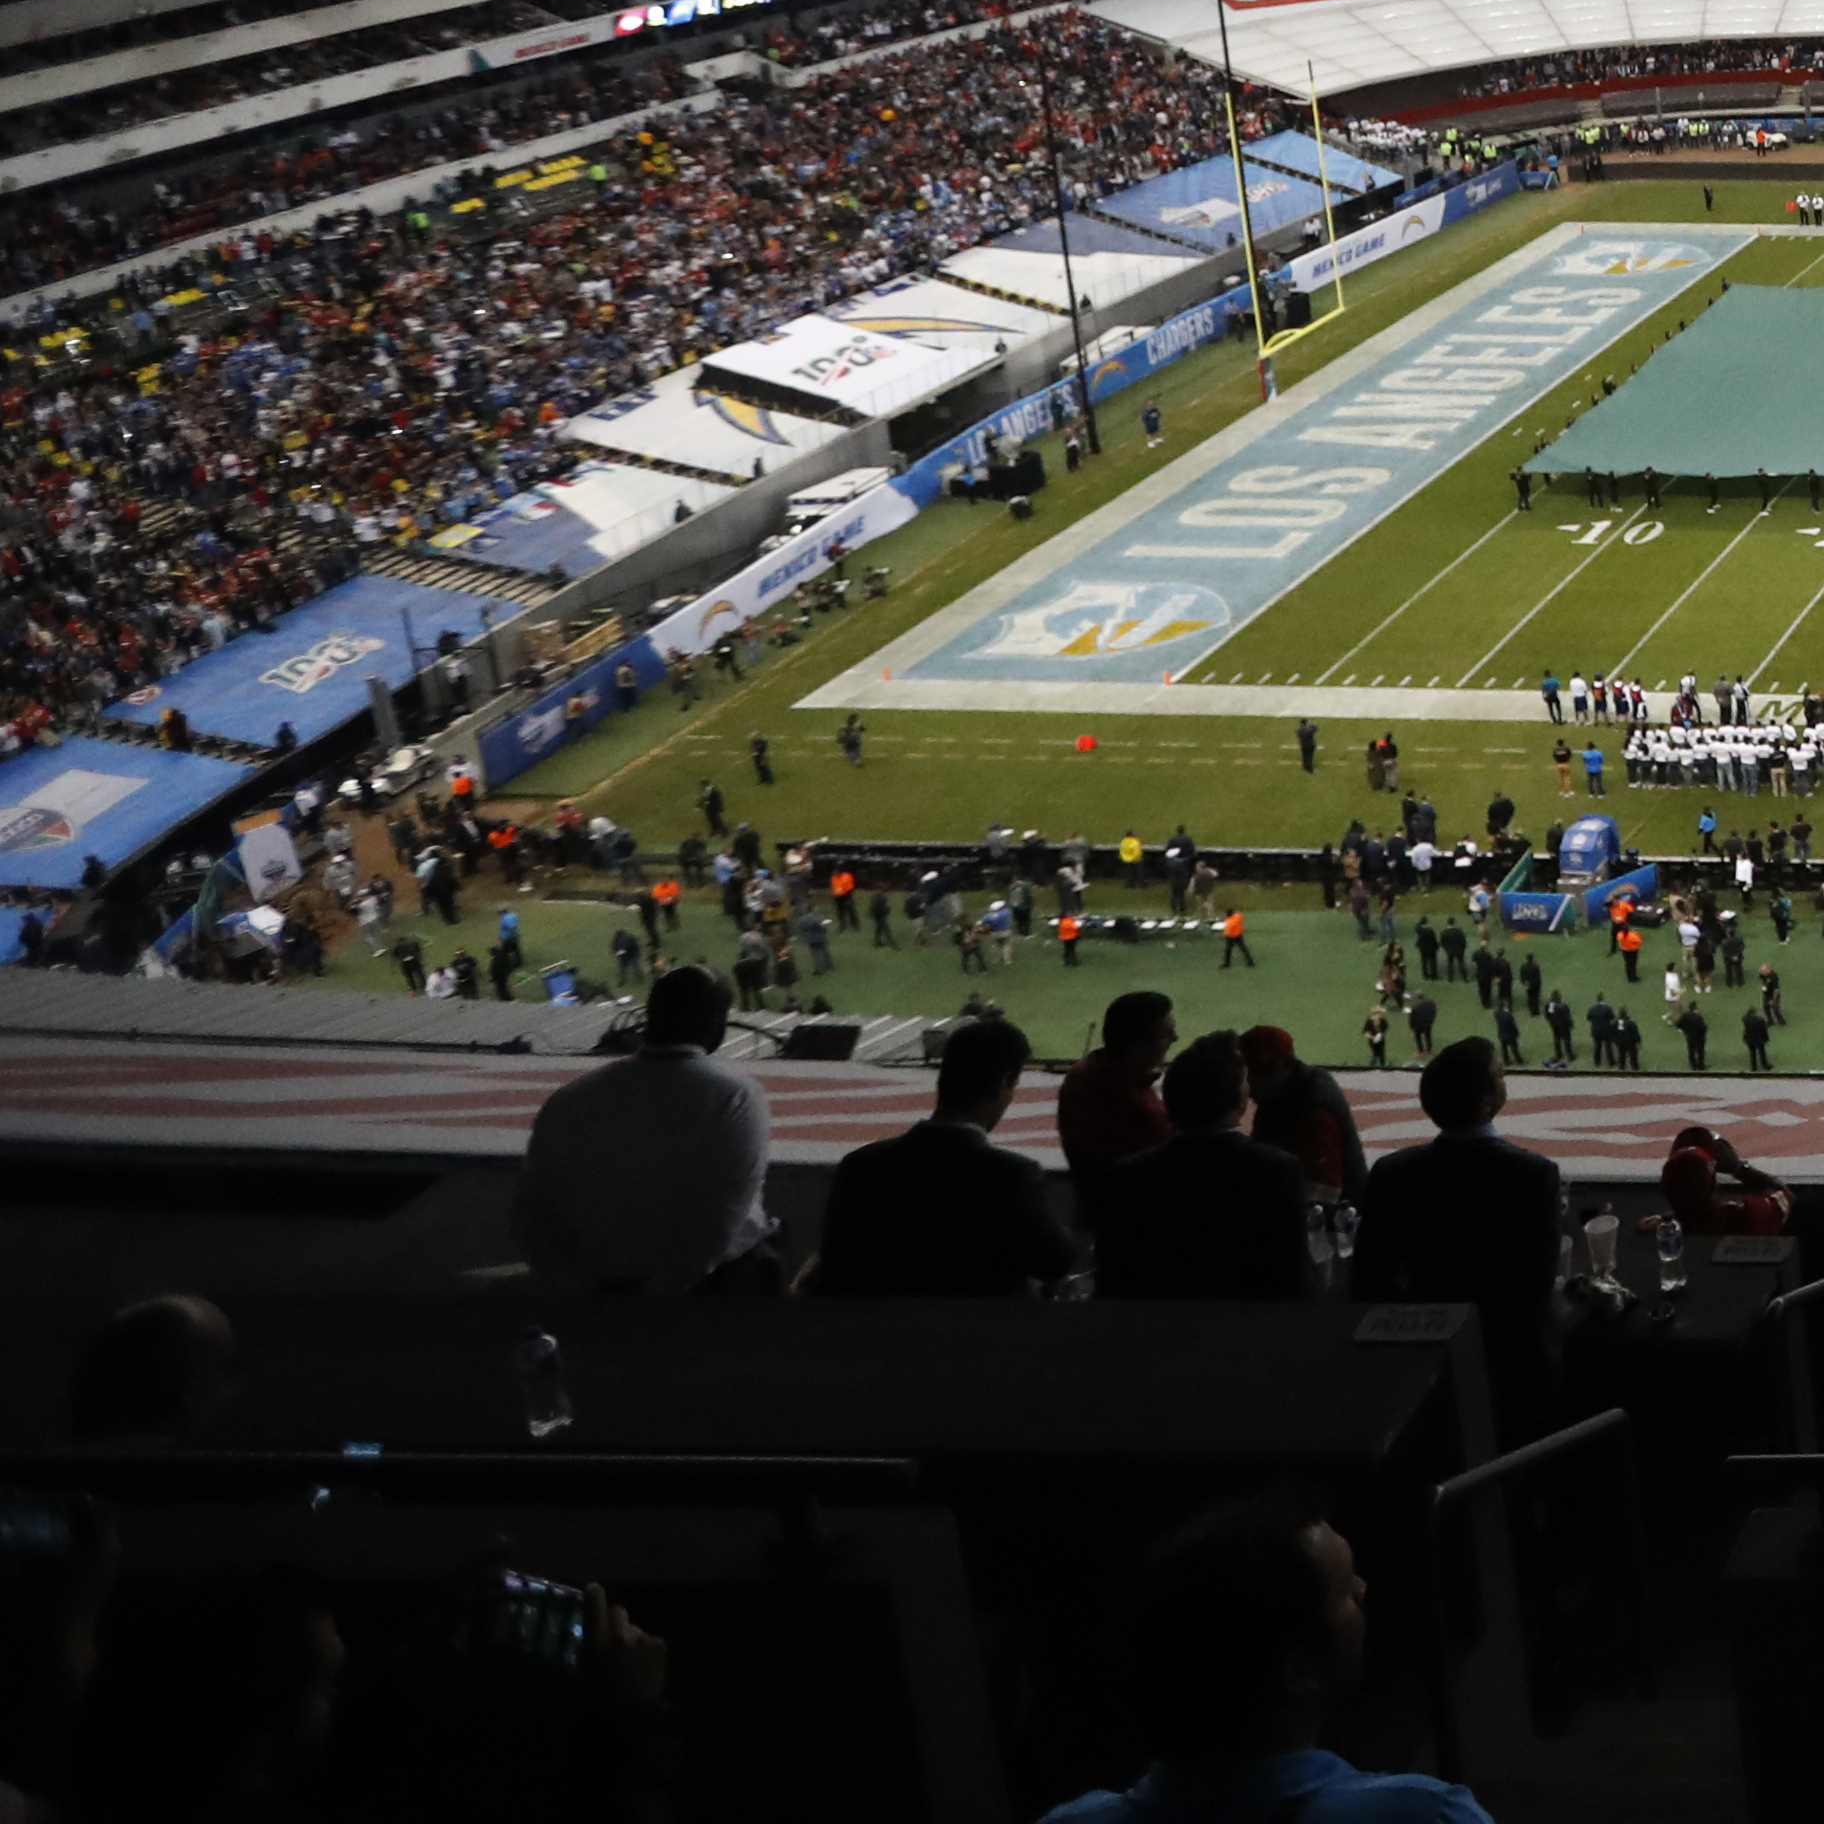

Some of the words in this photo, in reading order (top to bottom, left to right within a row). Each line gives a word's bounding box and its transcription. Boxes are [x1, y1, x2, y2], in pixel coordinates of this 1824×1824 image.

[1312, 249, 1353, 278] MEXCO
[1354, 233, 1386, 260] GAME
[1146, 311, 1215, 365] CHARGERS
[1001, 382, 1075, 441] ANGELS
[1122, 463, 1396, 560] LOS
[1297, 282, 1645, 451] ANGELES
[1573, 520, 1666, 547] 10
